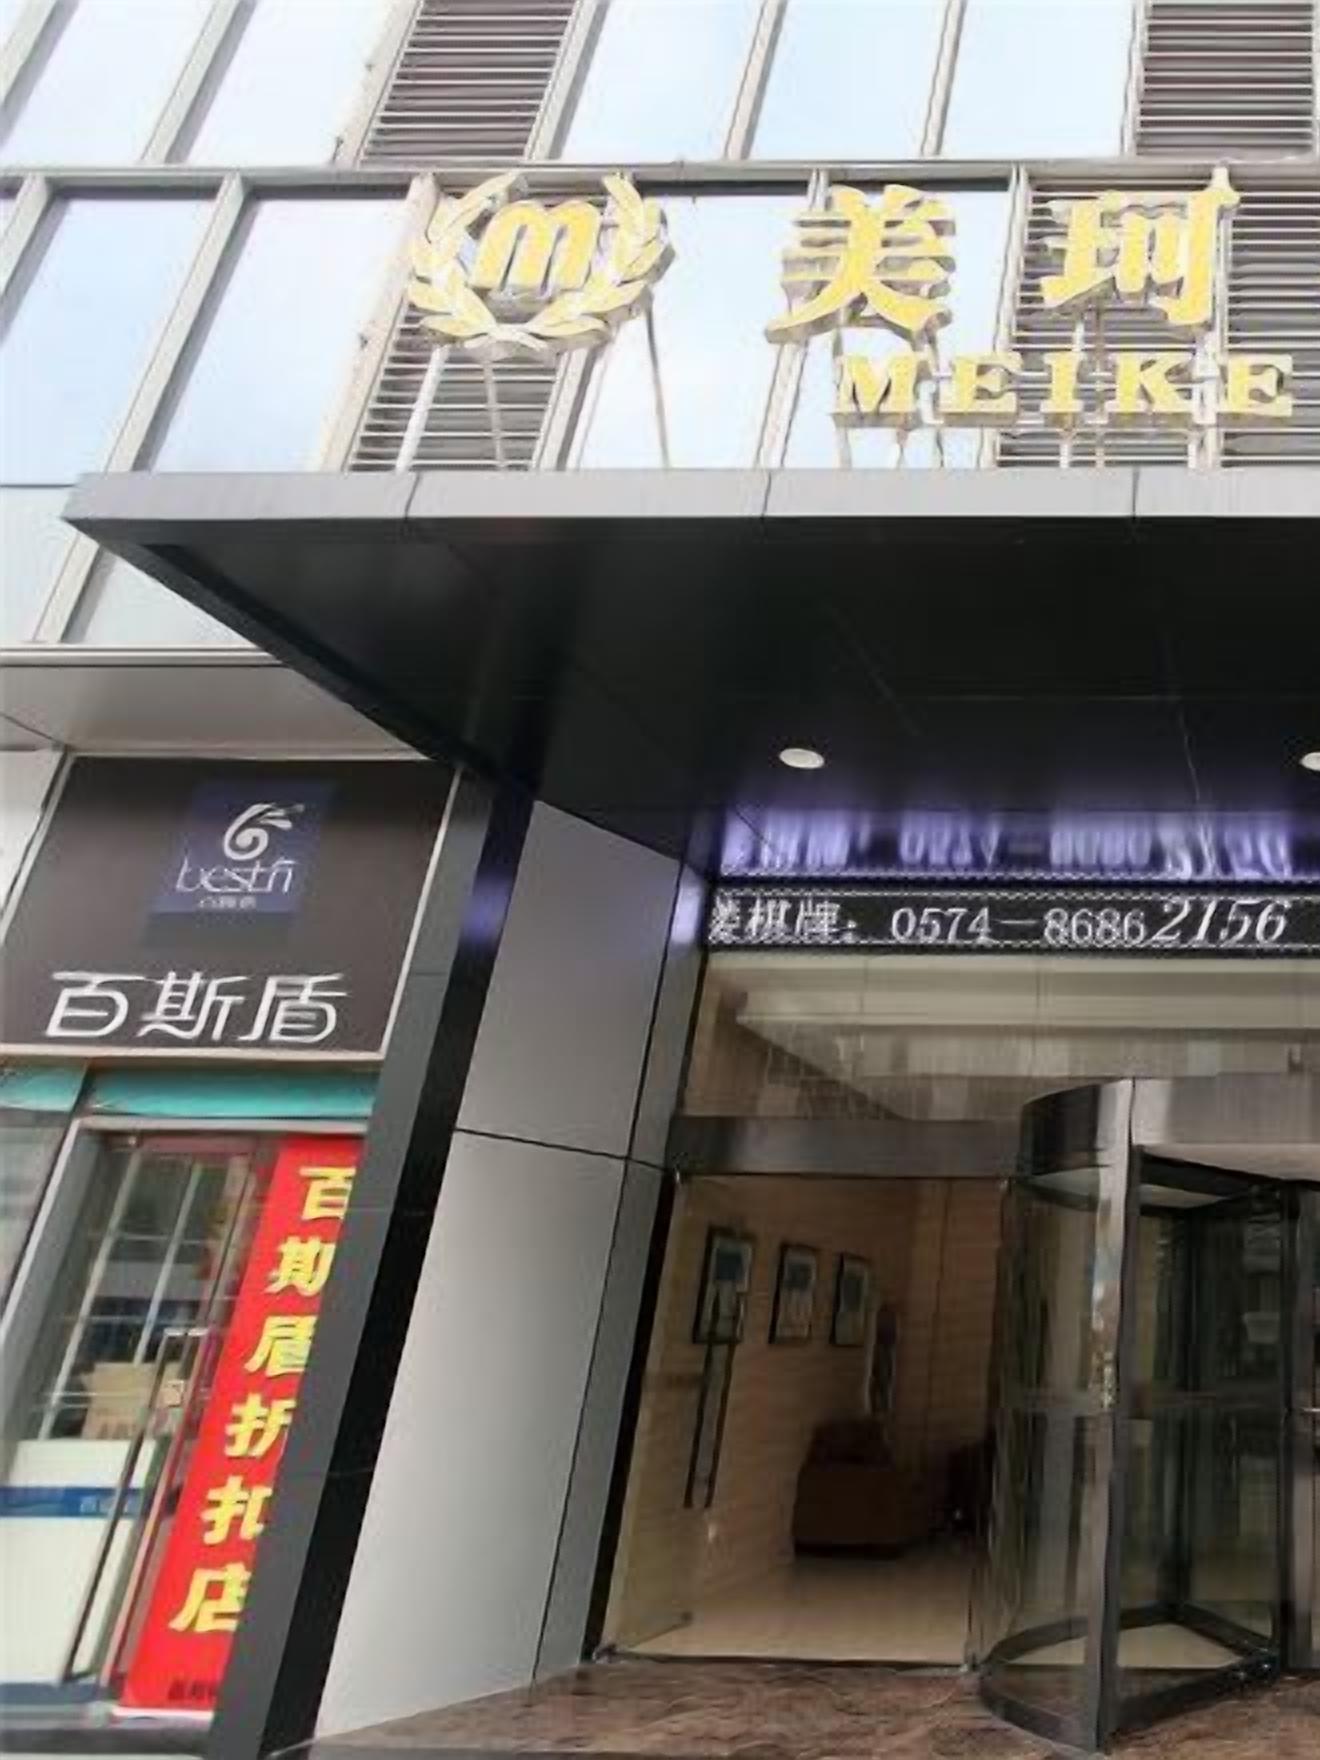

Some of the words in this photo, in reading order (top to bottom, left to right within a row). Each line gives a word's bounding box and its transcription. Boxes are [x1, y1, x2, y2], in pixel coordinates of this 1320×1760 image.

[832, 351, 1295, 424] MEIKE
[46, 970, 349, 1043] 百斯盾
